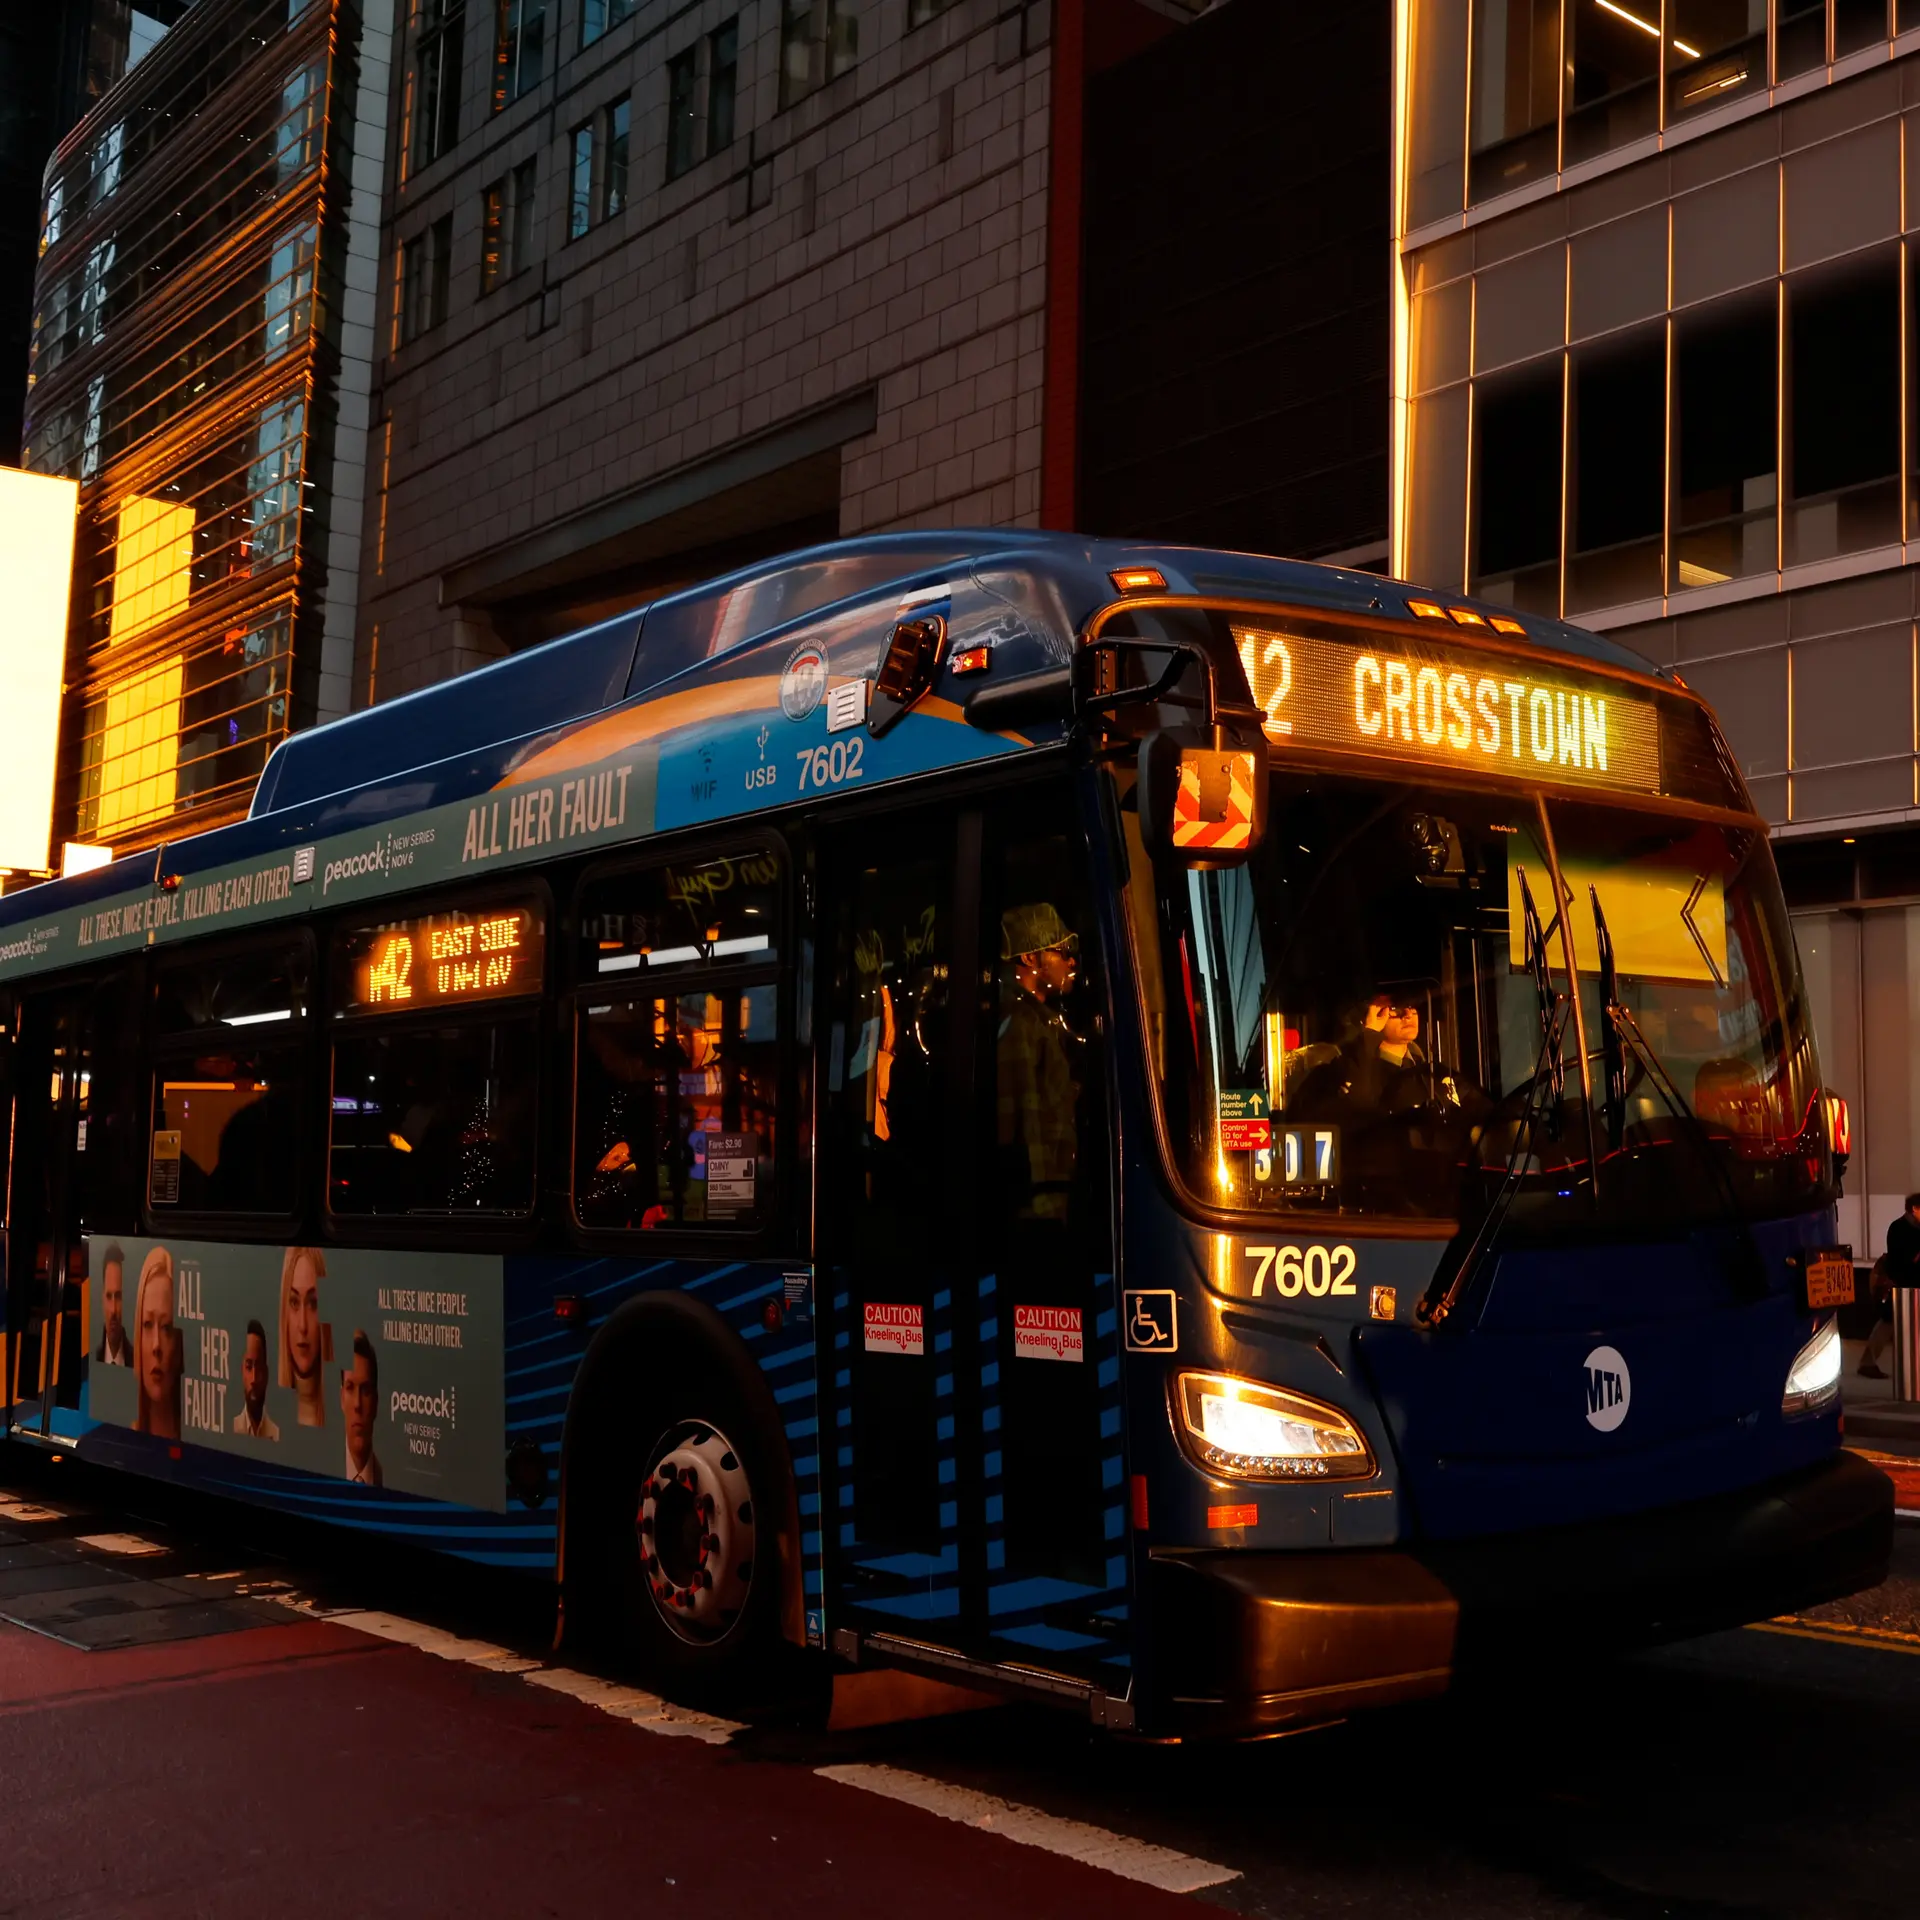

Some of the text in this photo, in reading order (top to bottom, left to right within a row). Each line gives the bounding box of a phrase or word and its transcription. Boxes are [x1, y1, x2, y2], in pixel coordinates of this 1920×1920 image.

[1353, 655, 1609, 771] CROSSTOWN
[796, 736, 864, 791] 7602
[744, 765, 777, 791] USB
[462, 765, 633, 863] ALL HER FAULT
[392, 828, 435, 851] NEW SERIES
[322, 841, 385, 895] peacock
[391, 854, 414, 869] NOV 6
[78, 917, 93, 947] ALL
[95, 909, 122, 942] THESE
[122, 902, 143, 935] NICE
[183, 881, 222, 921] KILLING
[223, 874, 253, 912] EACH
[253, 865, 292, 904] OTHER.
[431, 925, 475, 960] EAST
[479, 917, 520, 952] SIDE
[486, 955, 512, 987] AV
[1220, 1092, 1241, 1101] Route
[1221, 1101, 1247, 1109] number
[1221, 1109, 1243, 1117] above
[1221, 1124, 1248, 1132] Control
[1222, 1132, 1244, 1140] ID for
[1223, 1140, 1239, 1148] MTA
[1245, 1245, 1357, 1298] 7602
[178, 1270, 205, 1321] ALL
[378, 1288, 469, 1316] ALL THESE NICE PEOPLE.
[864, 1305, 922, 1325] CAUTION
[1016, 1308, 1081, 1329] CAUTION
[383, 1320, 463, 1348] KILLING EACH OTHER.
[865, 1327, 922, 1344] Kneeling Bus
[1016, 1331, 1082, 1349] Kneeling Bus
[200, 1325, 230, 1380] HER
[184, 1377, 227, 1433] FAULT
[390, 1389, 451, 1422] peacock
[404, 1423, 441, 1440] NEW SERIES
[409, 1438, 436, 1458] NOV 6
